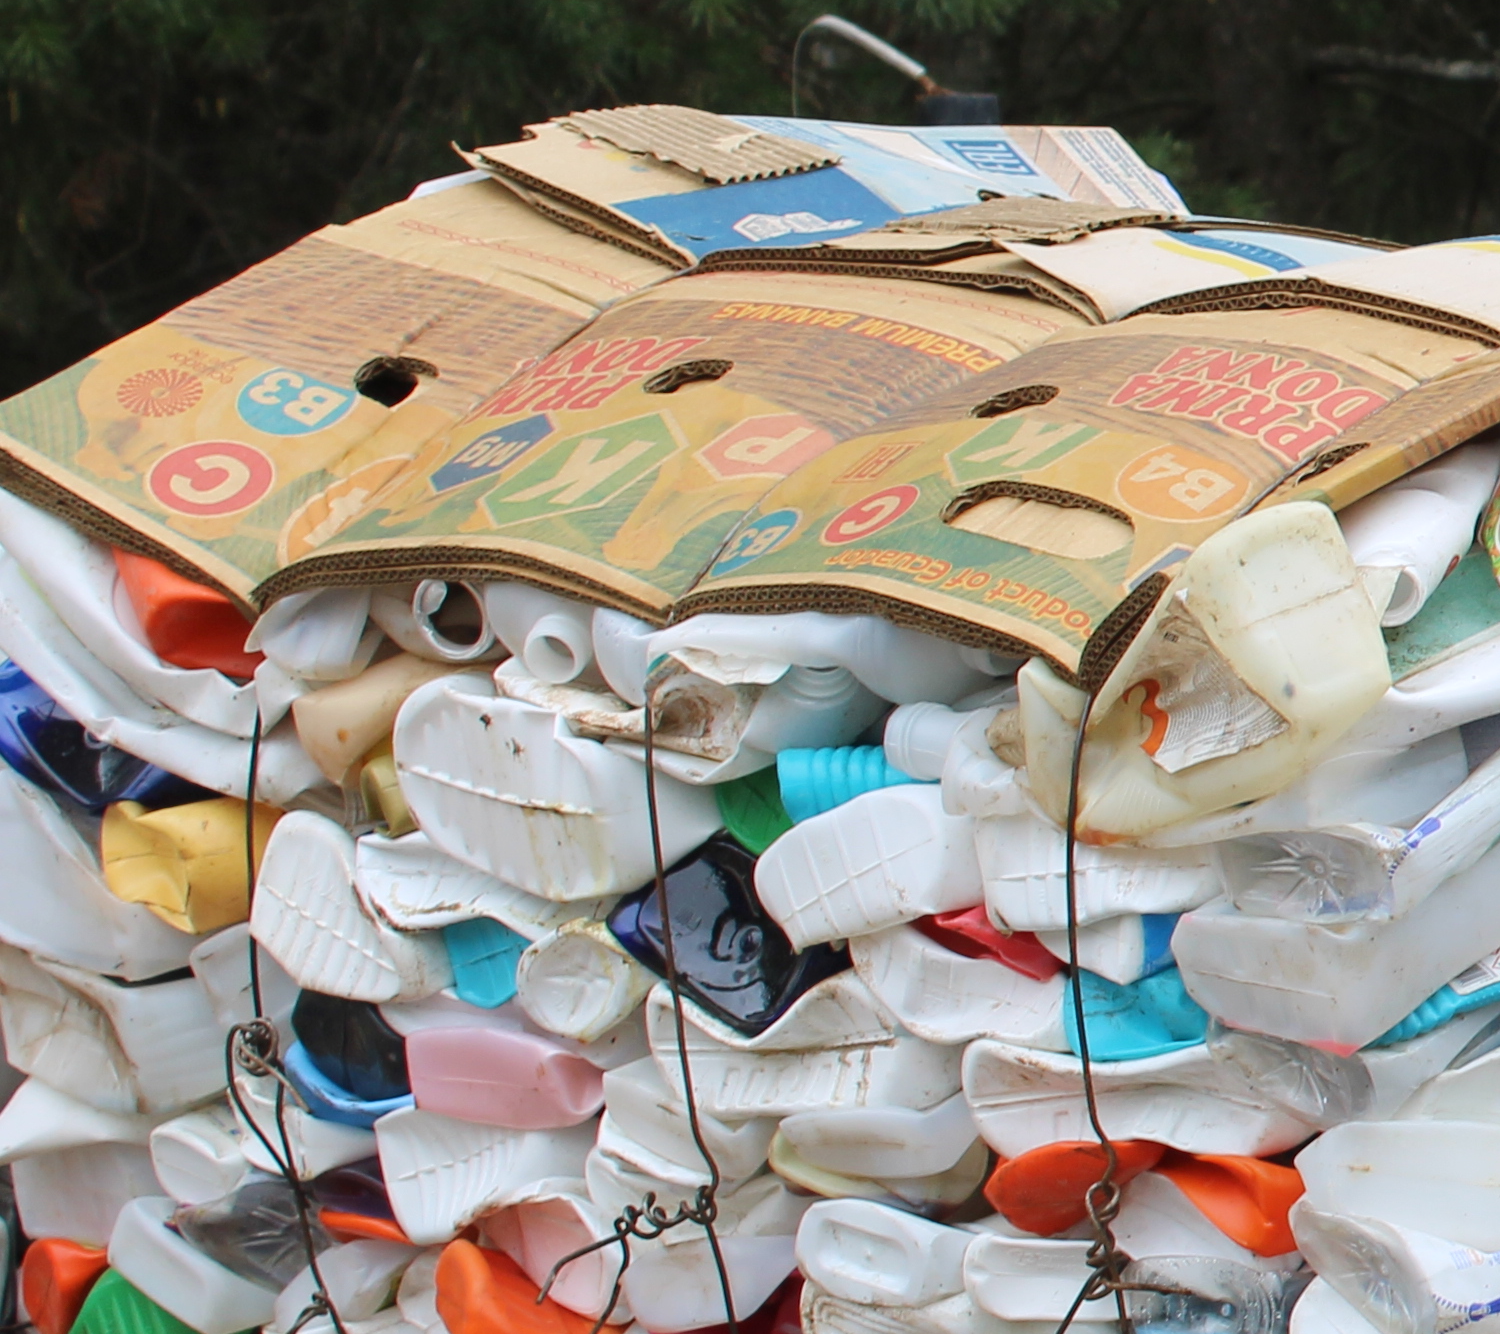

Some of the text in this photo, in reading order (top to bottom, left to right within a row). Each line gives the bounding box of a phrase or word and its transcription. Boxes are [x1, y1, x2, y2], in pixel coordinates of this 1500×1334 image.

[710, 301, 1005, 374] PREMIUM BANANAS
[248, 371, 342, 427] B3
[1155, 345, 1392, 431] DONNA
[724, 425, 817, 466] P
[967, 419, 1087, 470] K
[1109, 373, 1338, 462] PRIMA
[168, 454, 250, 504] C
[459, 436, 531, 468] Mg
[500, 437, 655, 506] K
[1129, 452, 1237, 514] B4
[838, 495, 902, 535] C
[720, 523, 791, 564] B3
[823, 547, 1096, 638] oduct of Ecuador
